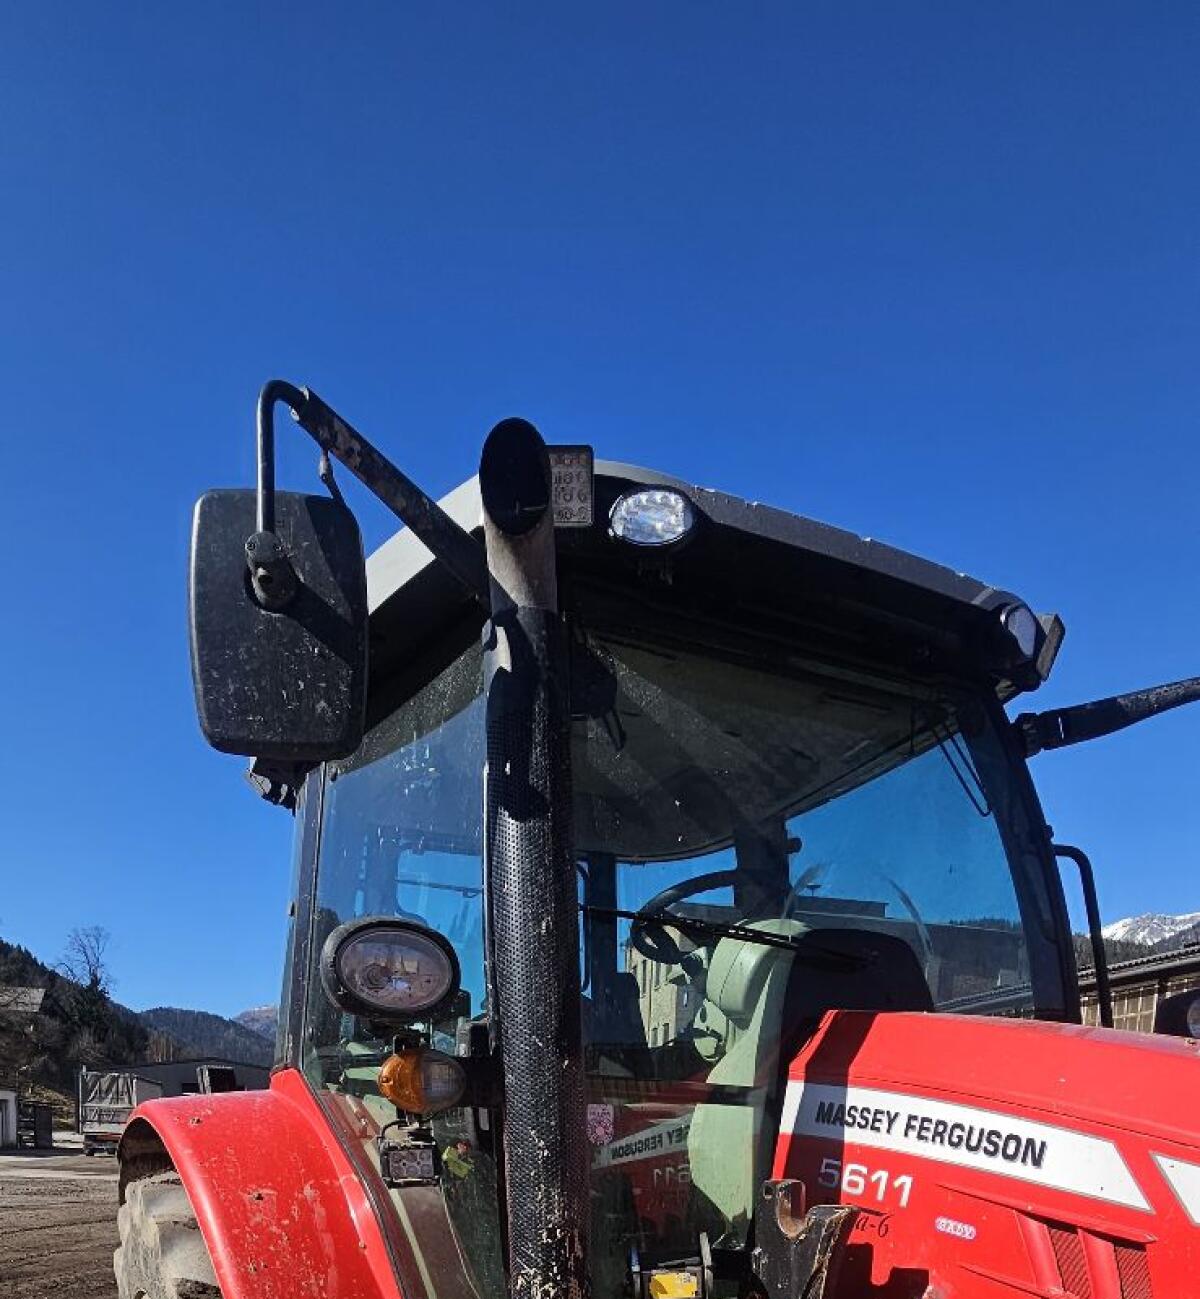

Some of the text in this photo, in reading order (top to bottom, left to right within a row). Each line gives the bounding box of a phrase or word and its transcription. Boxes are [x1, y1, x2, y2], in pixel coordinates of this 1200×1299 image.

[815, 1101, 1047, 1168] MASSEY FERGUSON
[818, 1158, 913, 1208] 5611
